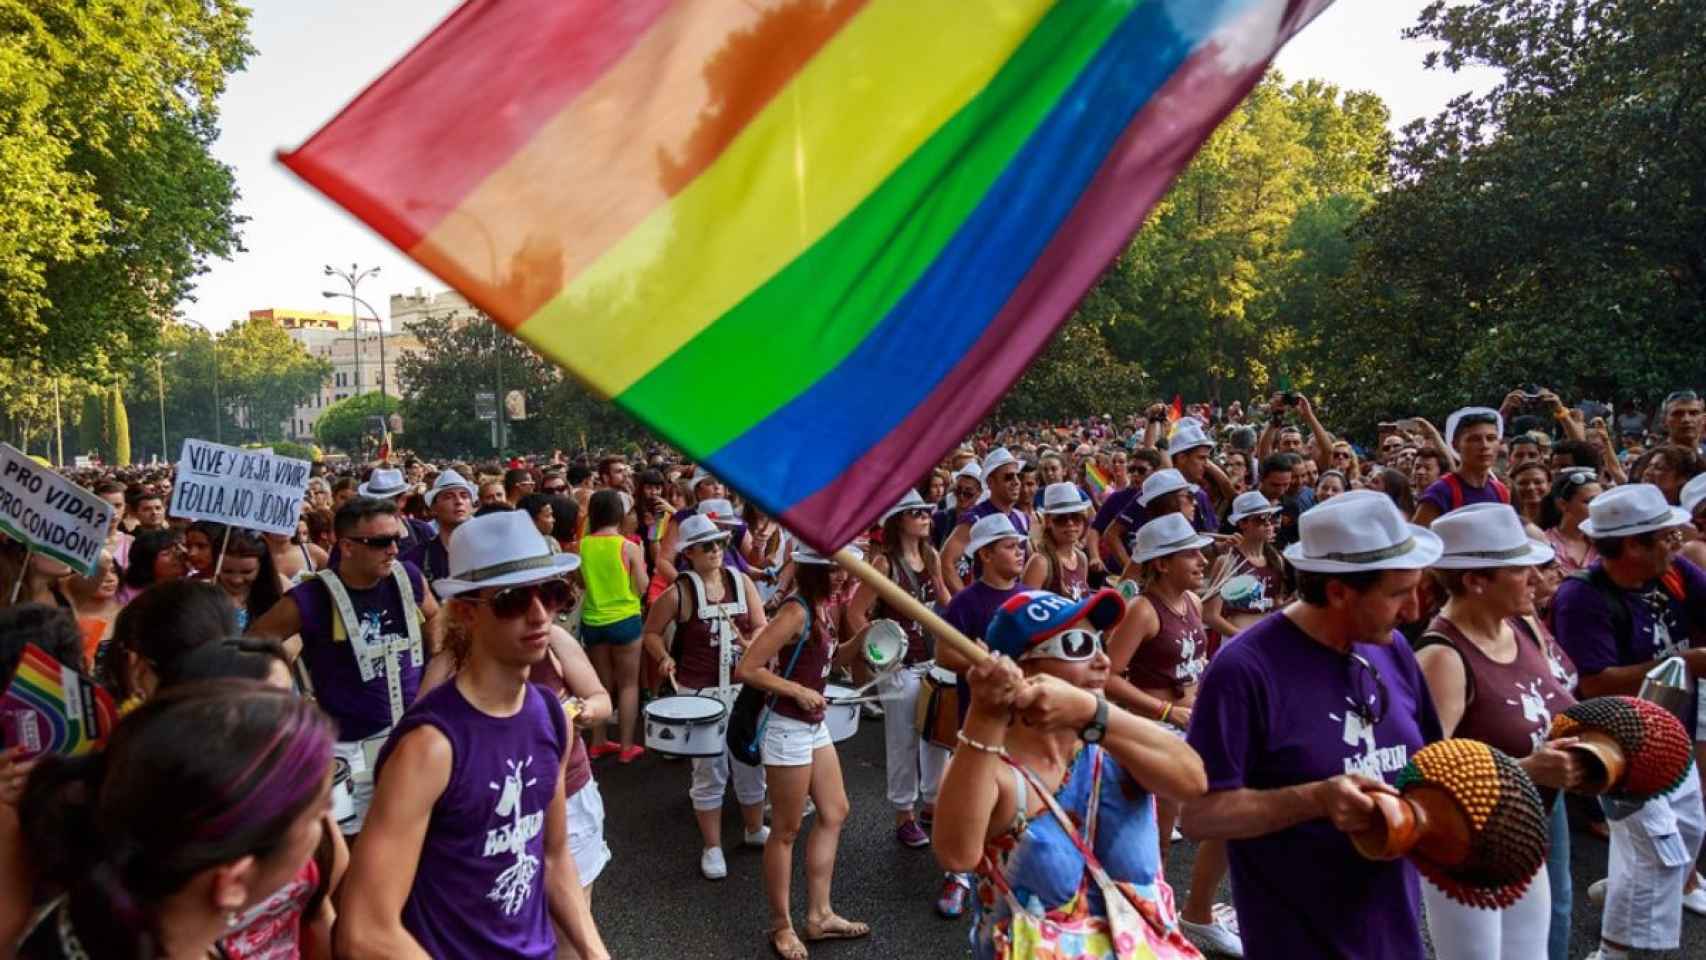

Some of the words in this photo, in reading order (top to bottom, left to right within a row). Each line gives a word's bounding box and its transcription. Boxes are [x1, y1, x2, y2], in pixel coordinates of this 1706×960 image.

[189, 445, 224, 473] VIVE
[227, 453, 237, 475] Y
[240, 455, 271, 481] DEJA
[4, 461, 42, 493] PRO
[45, 485, 106, 528] VIDA?
[230, 489, 253, 519] NO
[23, 507, 98, 562] CONDÓN!
